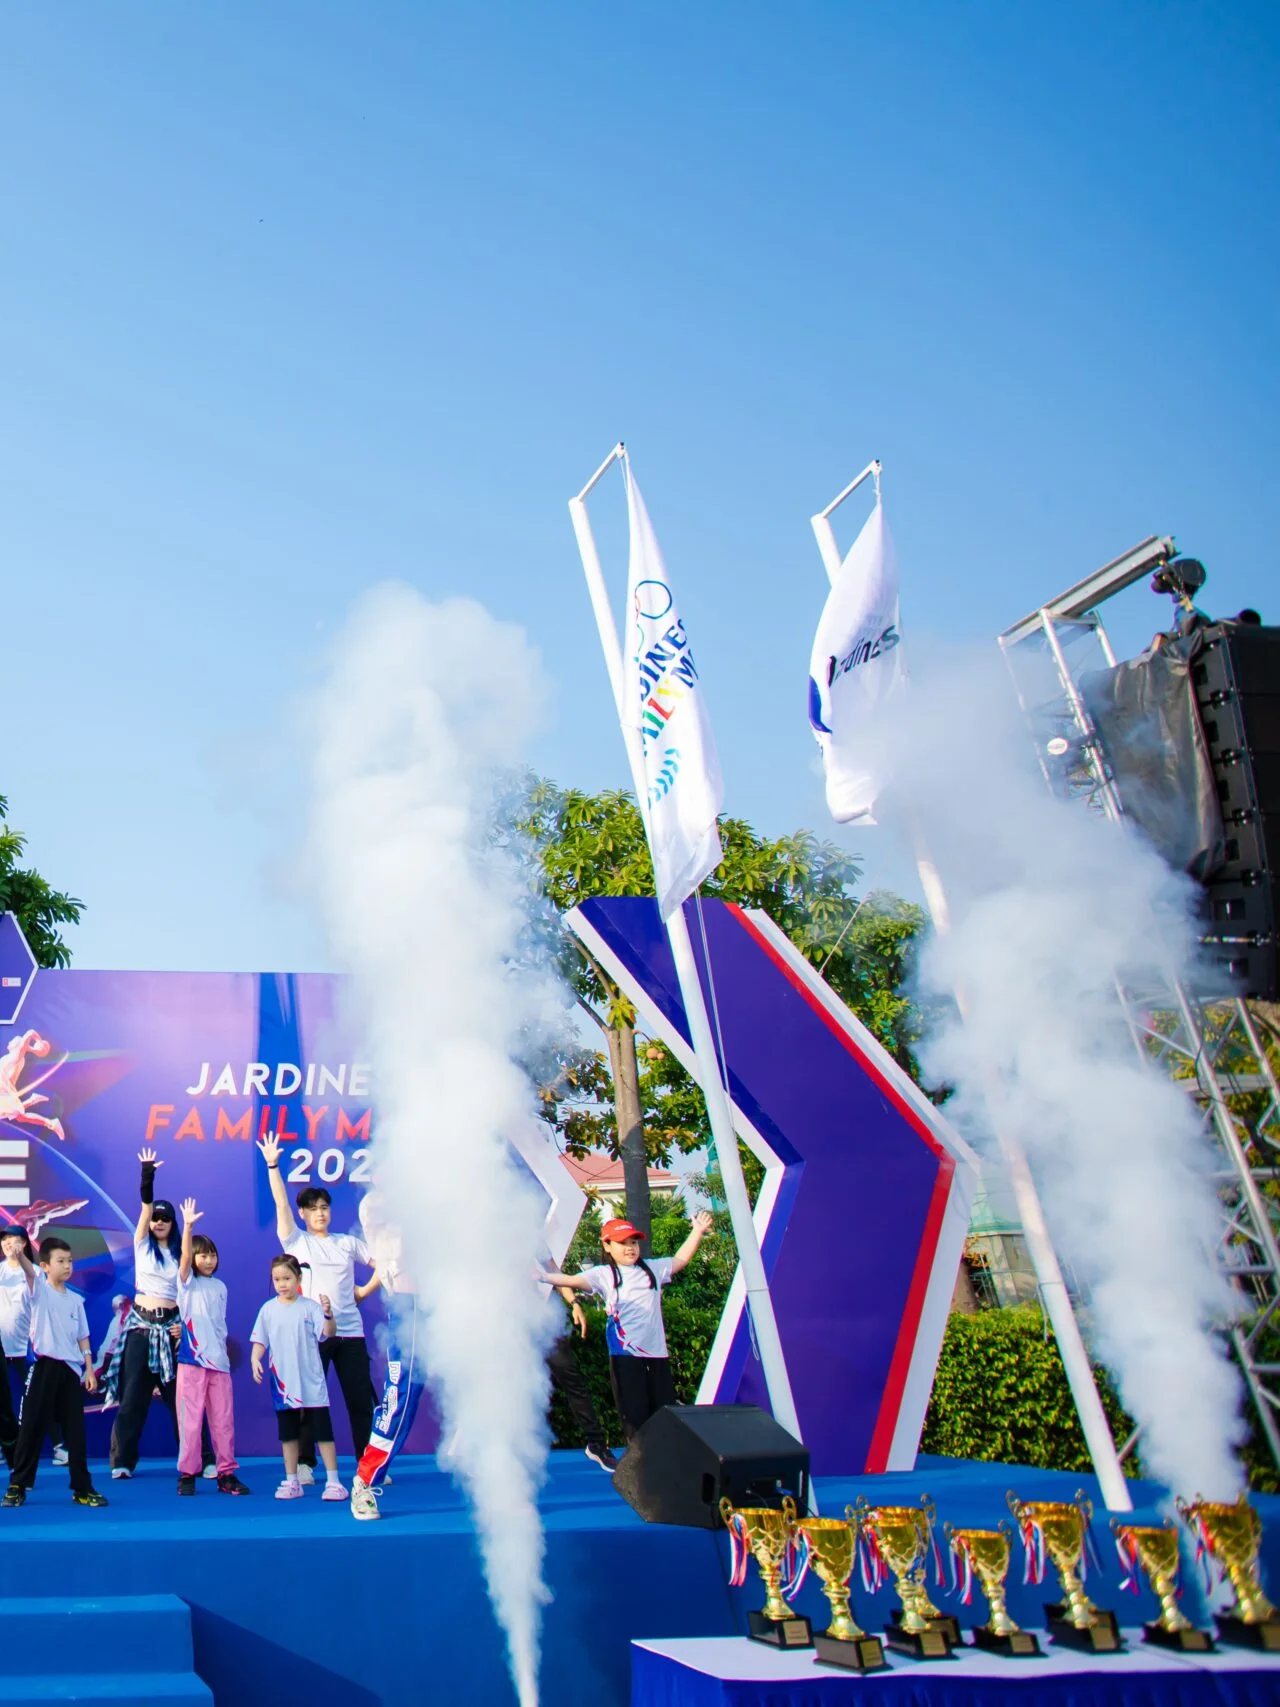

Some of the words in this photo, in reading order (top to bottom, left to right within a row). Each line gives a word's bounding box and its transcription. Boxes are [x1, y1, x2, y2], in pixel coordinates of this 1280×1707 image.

[185, 1062, 372, 1097] JARDINE
[145, 1104, 373, 1142] FAMILYM
[287, 1148, 374, 1184] 202
